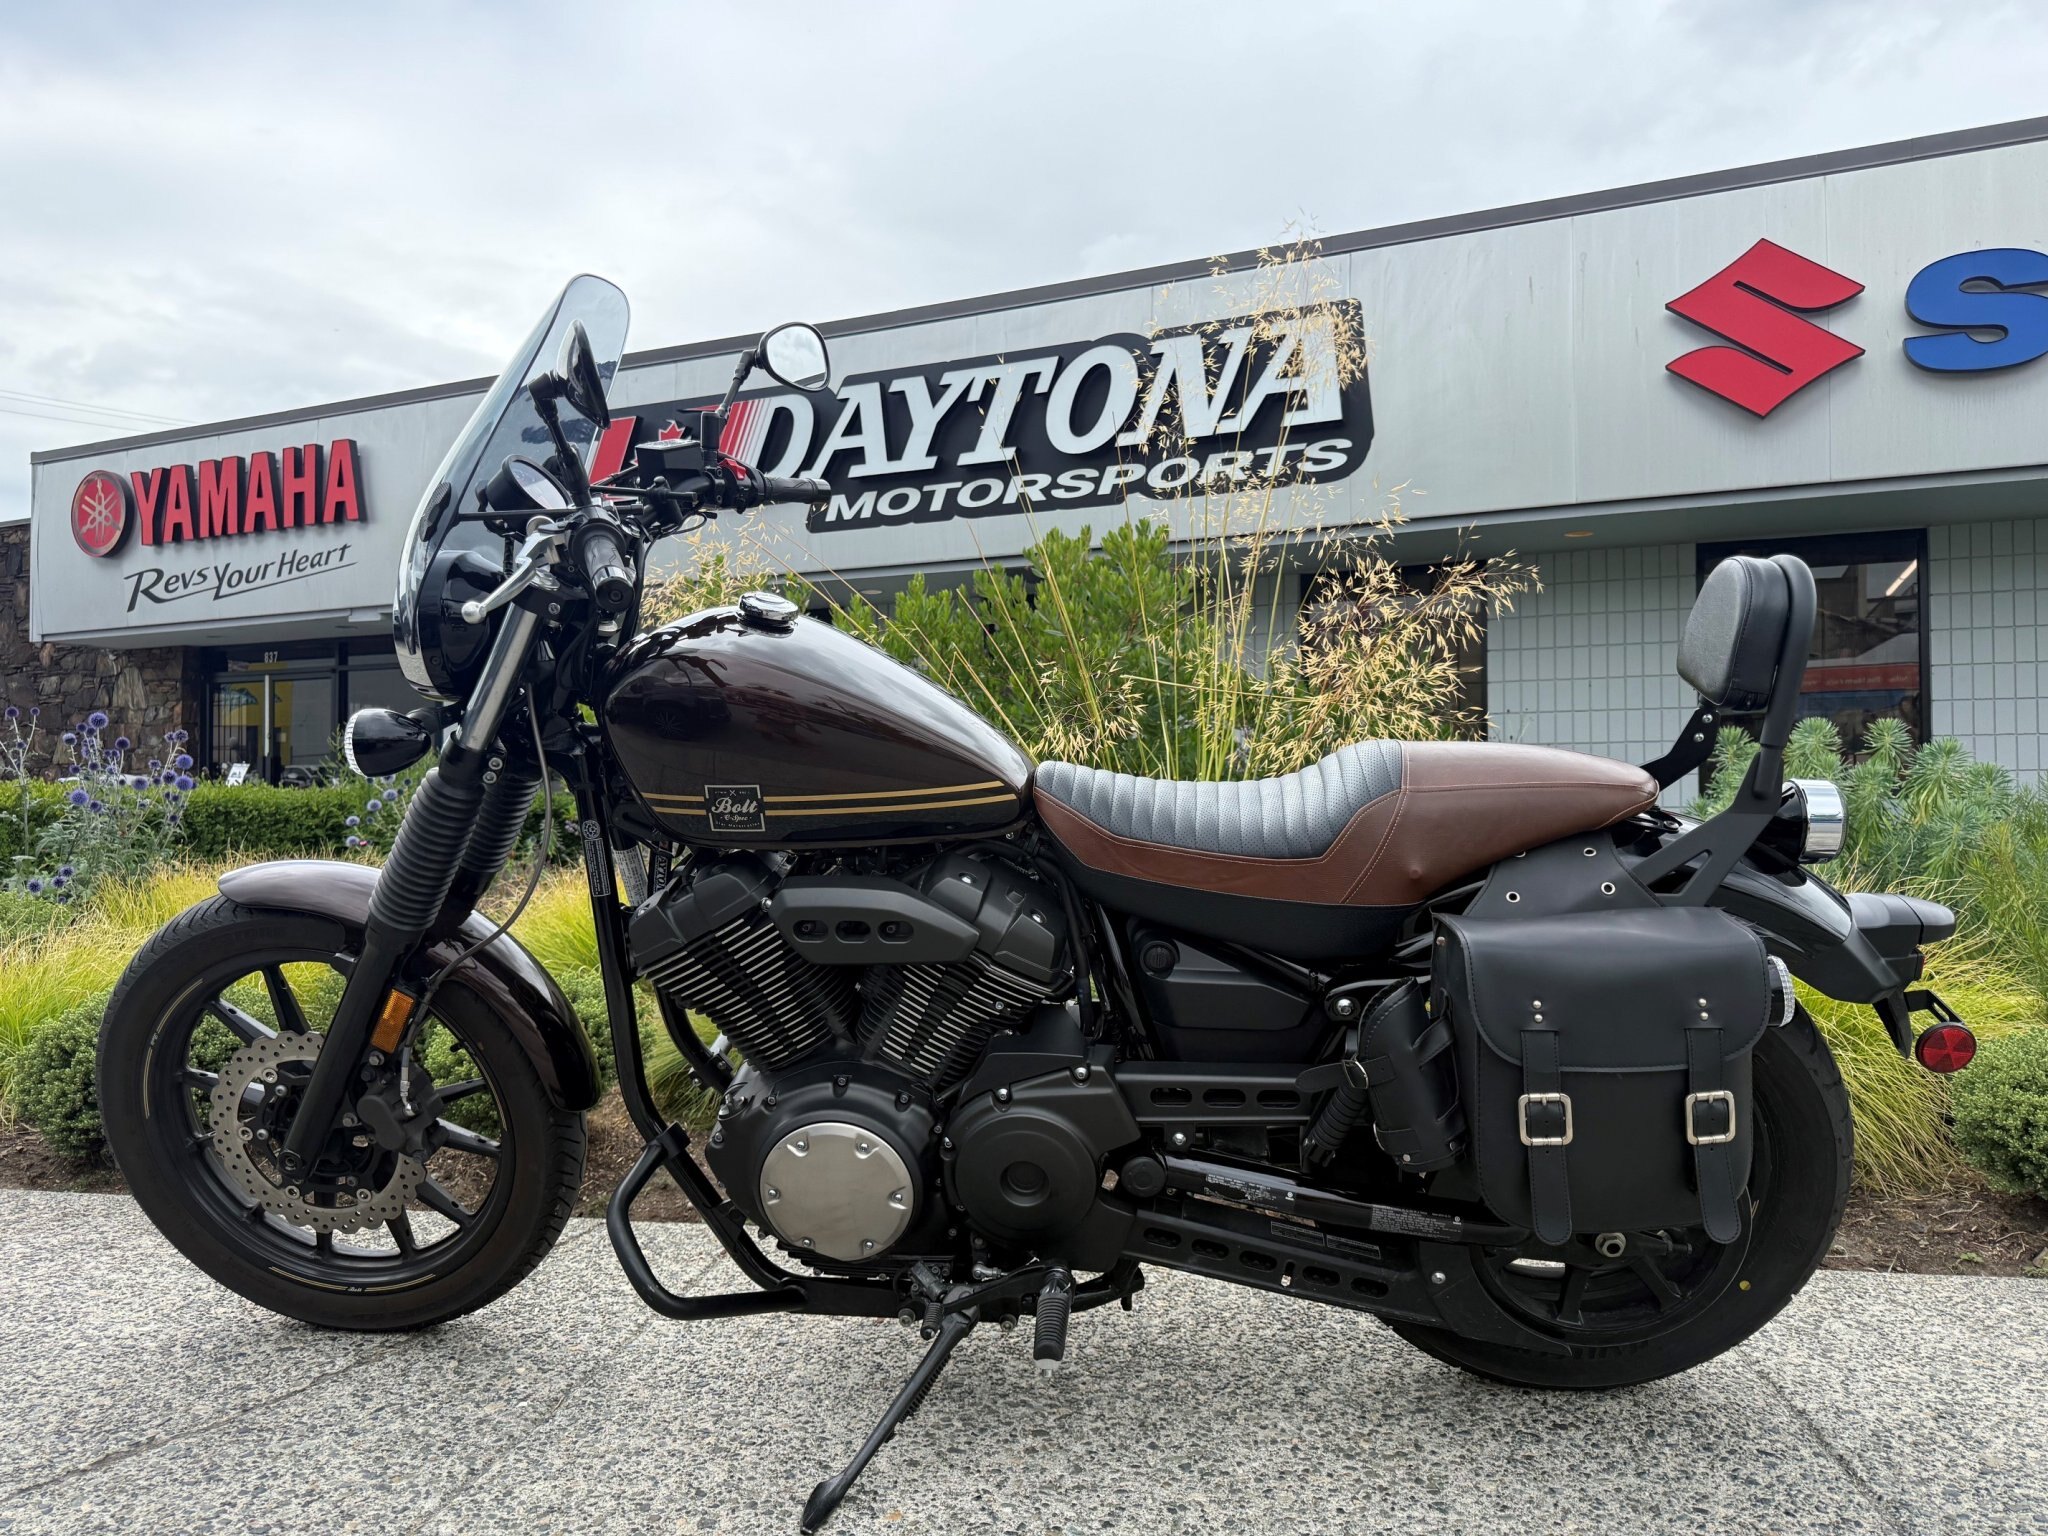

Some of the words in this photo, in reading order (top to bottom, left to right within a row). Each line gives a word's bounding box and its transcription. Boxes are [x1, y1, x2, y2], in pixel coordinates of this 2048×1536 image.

[716, 313, 1345, 480] DAYTONA
[130, 438, 364, 546] YAMAHA
[824, 437, 1355, 523] MOTORSPORTS
[124, 565, 214, 613] Revs
[212, 561, 276, 601] Your
[276, 542, 353, 578] Heart
[264, 651, 279, 663] 837
[711, 797, 758, 813] Bolt
